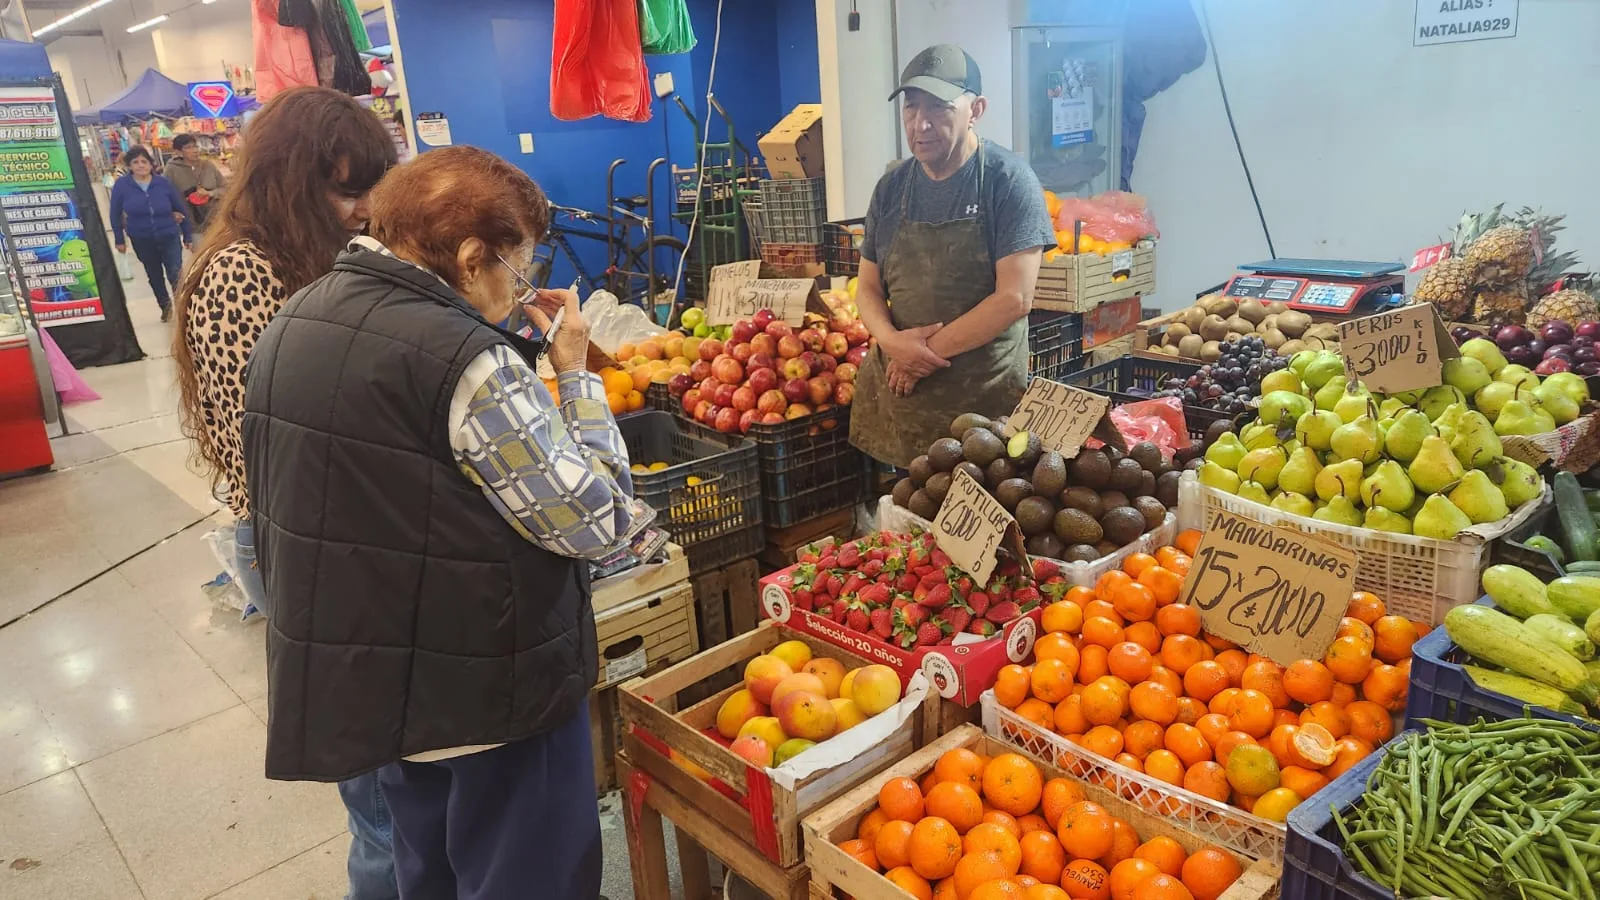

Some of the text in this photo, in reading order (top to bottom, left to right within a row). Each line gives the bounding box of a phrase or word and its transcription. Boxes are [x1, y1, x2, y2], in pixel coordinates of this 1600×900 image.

[1439, 0, 1484, 13] ALIAS
[1419, 18, 1511, 38] NATALIA929
[2, 160, 50, 172] TÉCNICO
[1340, 313, 1402, 339] PERAS
[1027, 377, 1094, 414] PALTAS
[955, 470, 1009, 534] FRUTILLAS
[1210, 512, 1351, 579] MANDARINAS
[1185, 546, 1239, 611] 15
[805, 613, 904, 667] Selección 20 años
